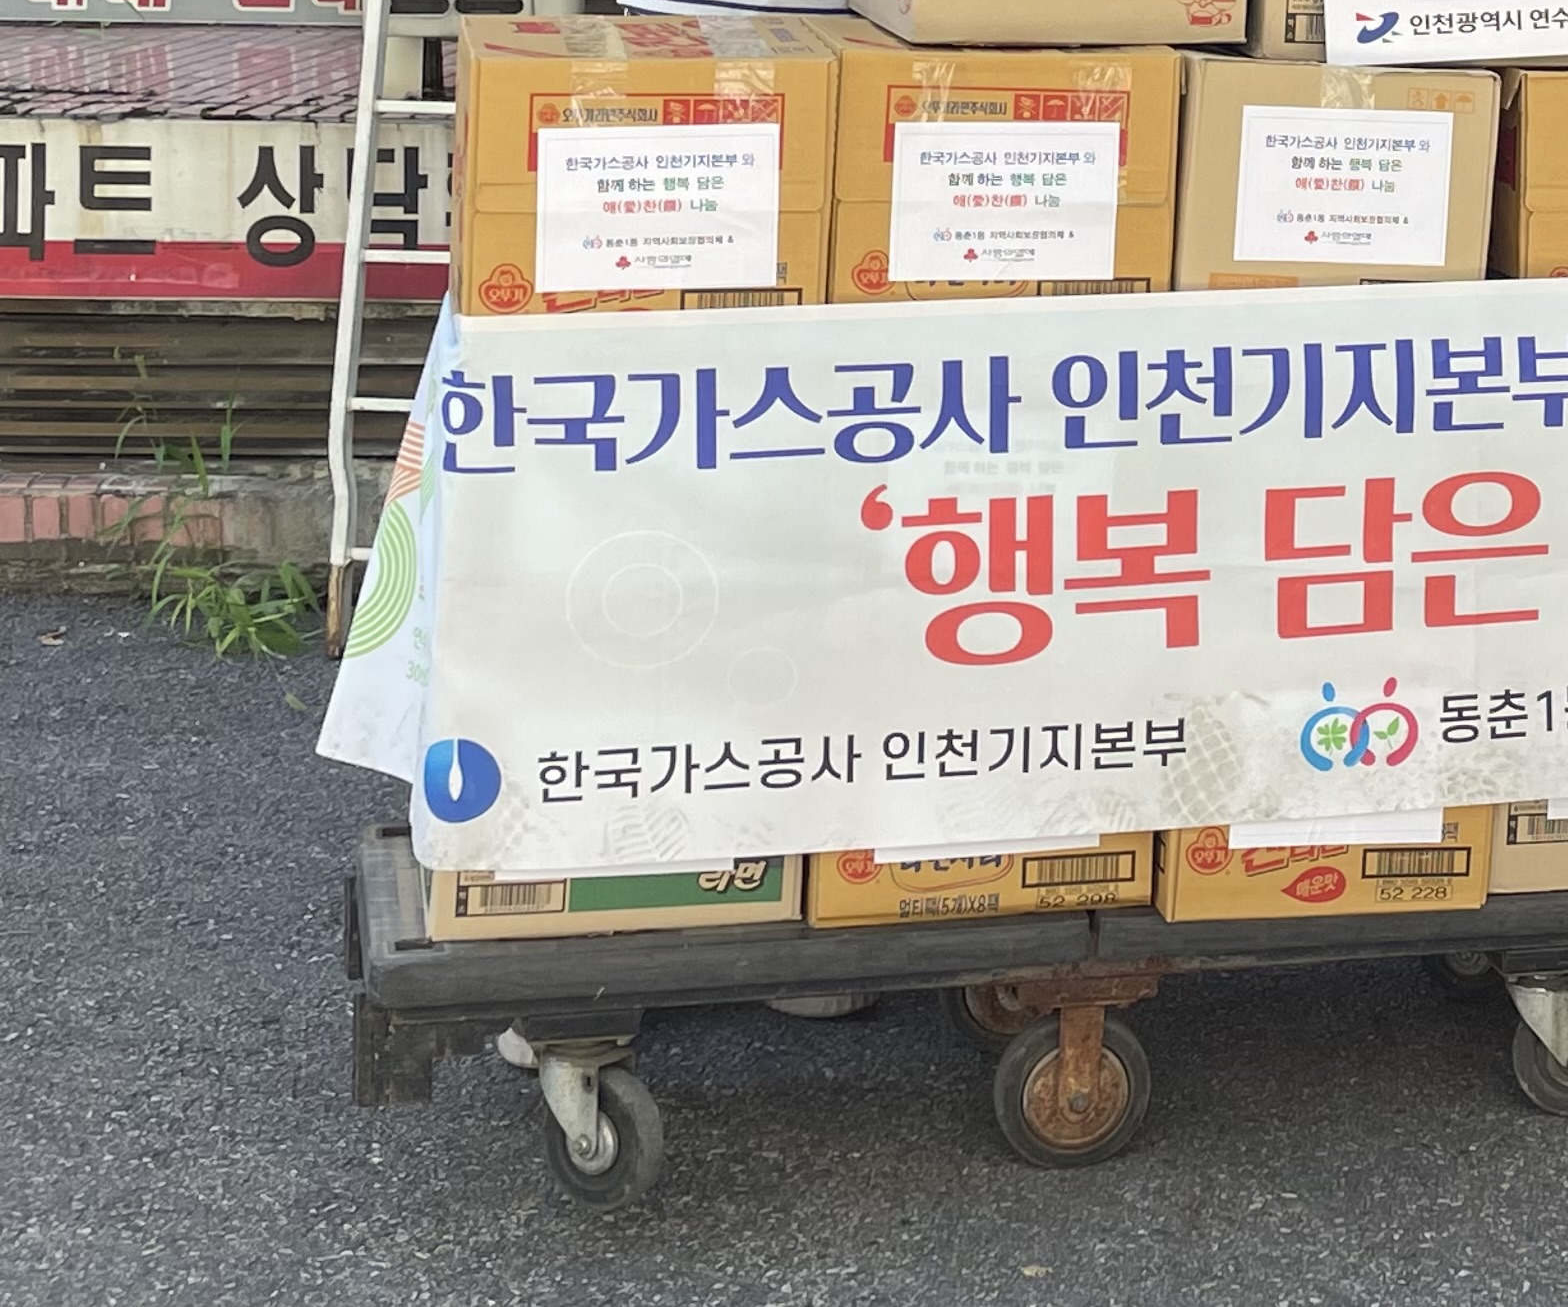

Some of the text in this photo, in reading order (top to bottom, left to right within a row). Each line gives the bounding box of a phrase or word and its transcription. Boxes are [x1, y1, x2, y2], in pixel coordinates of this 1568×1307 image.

[1410, 10, 1522, 35] 인천광역시
[1265, 135, 1338, 149] 한국가스공사
[1344, 137, 1416, 152] 인천기지본부
[565, 156, 649, 171] 한국가스공사
[656, 154, 738, 169] 인천기지본부
[920, 151, 997, 165] 한국가스공사
[1004, 152, 1080, 165] 인천기지본부
[1292, 156, 1315, 169] 함께
[1319, 157, 1343, 170] 하는
[597, 179, 624, 193] 함께
[628, 178, 655, 191] 하는
[948, 173, 974, 186] 함께
[978, 173, 1003, 186] 하는
[441, 356, 1022, 474] 한국가스공사
[1265, 471, 1549, 639] 담은
[538, 718, 1186, 803] 한국가스공사 인천기지본부
[1378, 885, 1448, 901] 52 228
